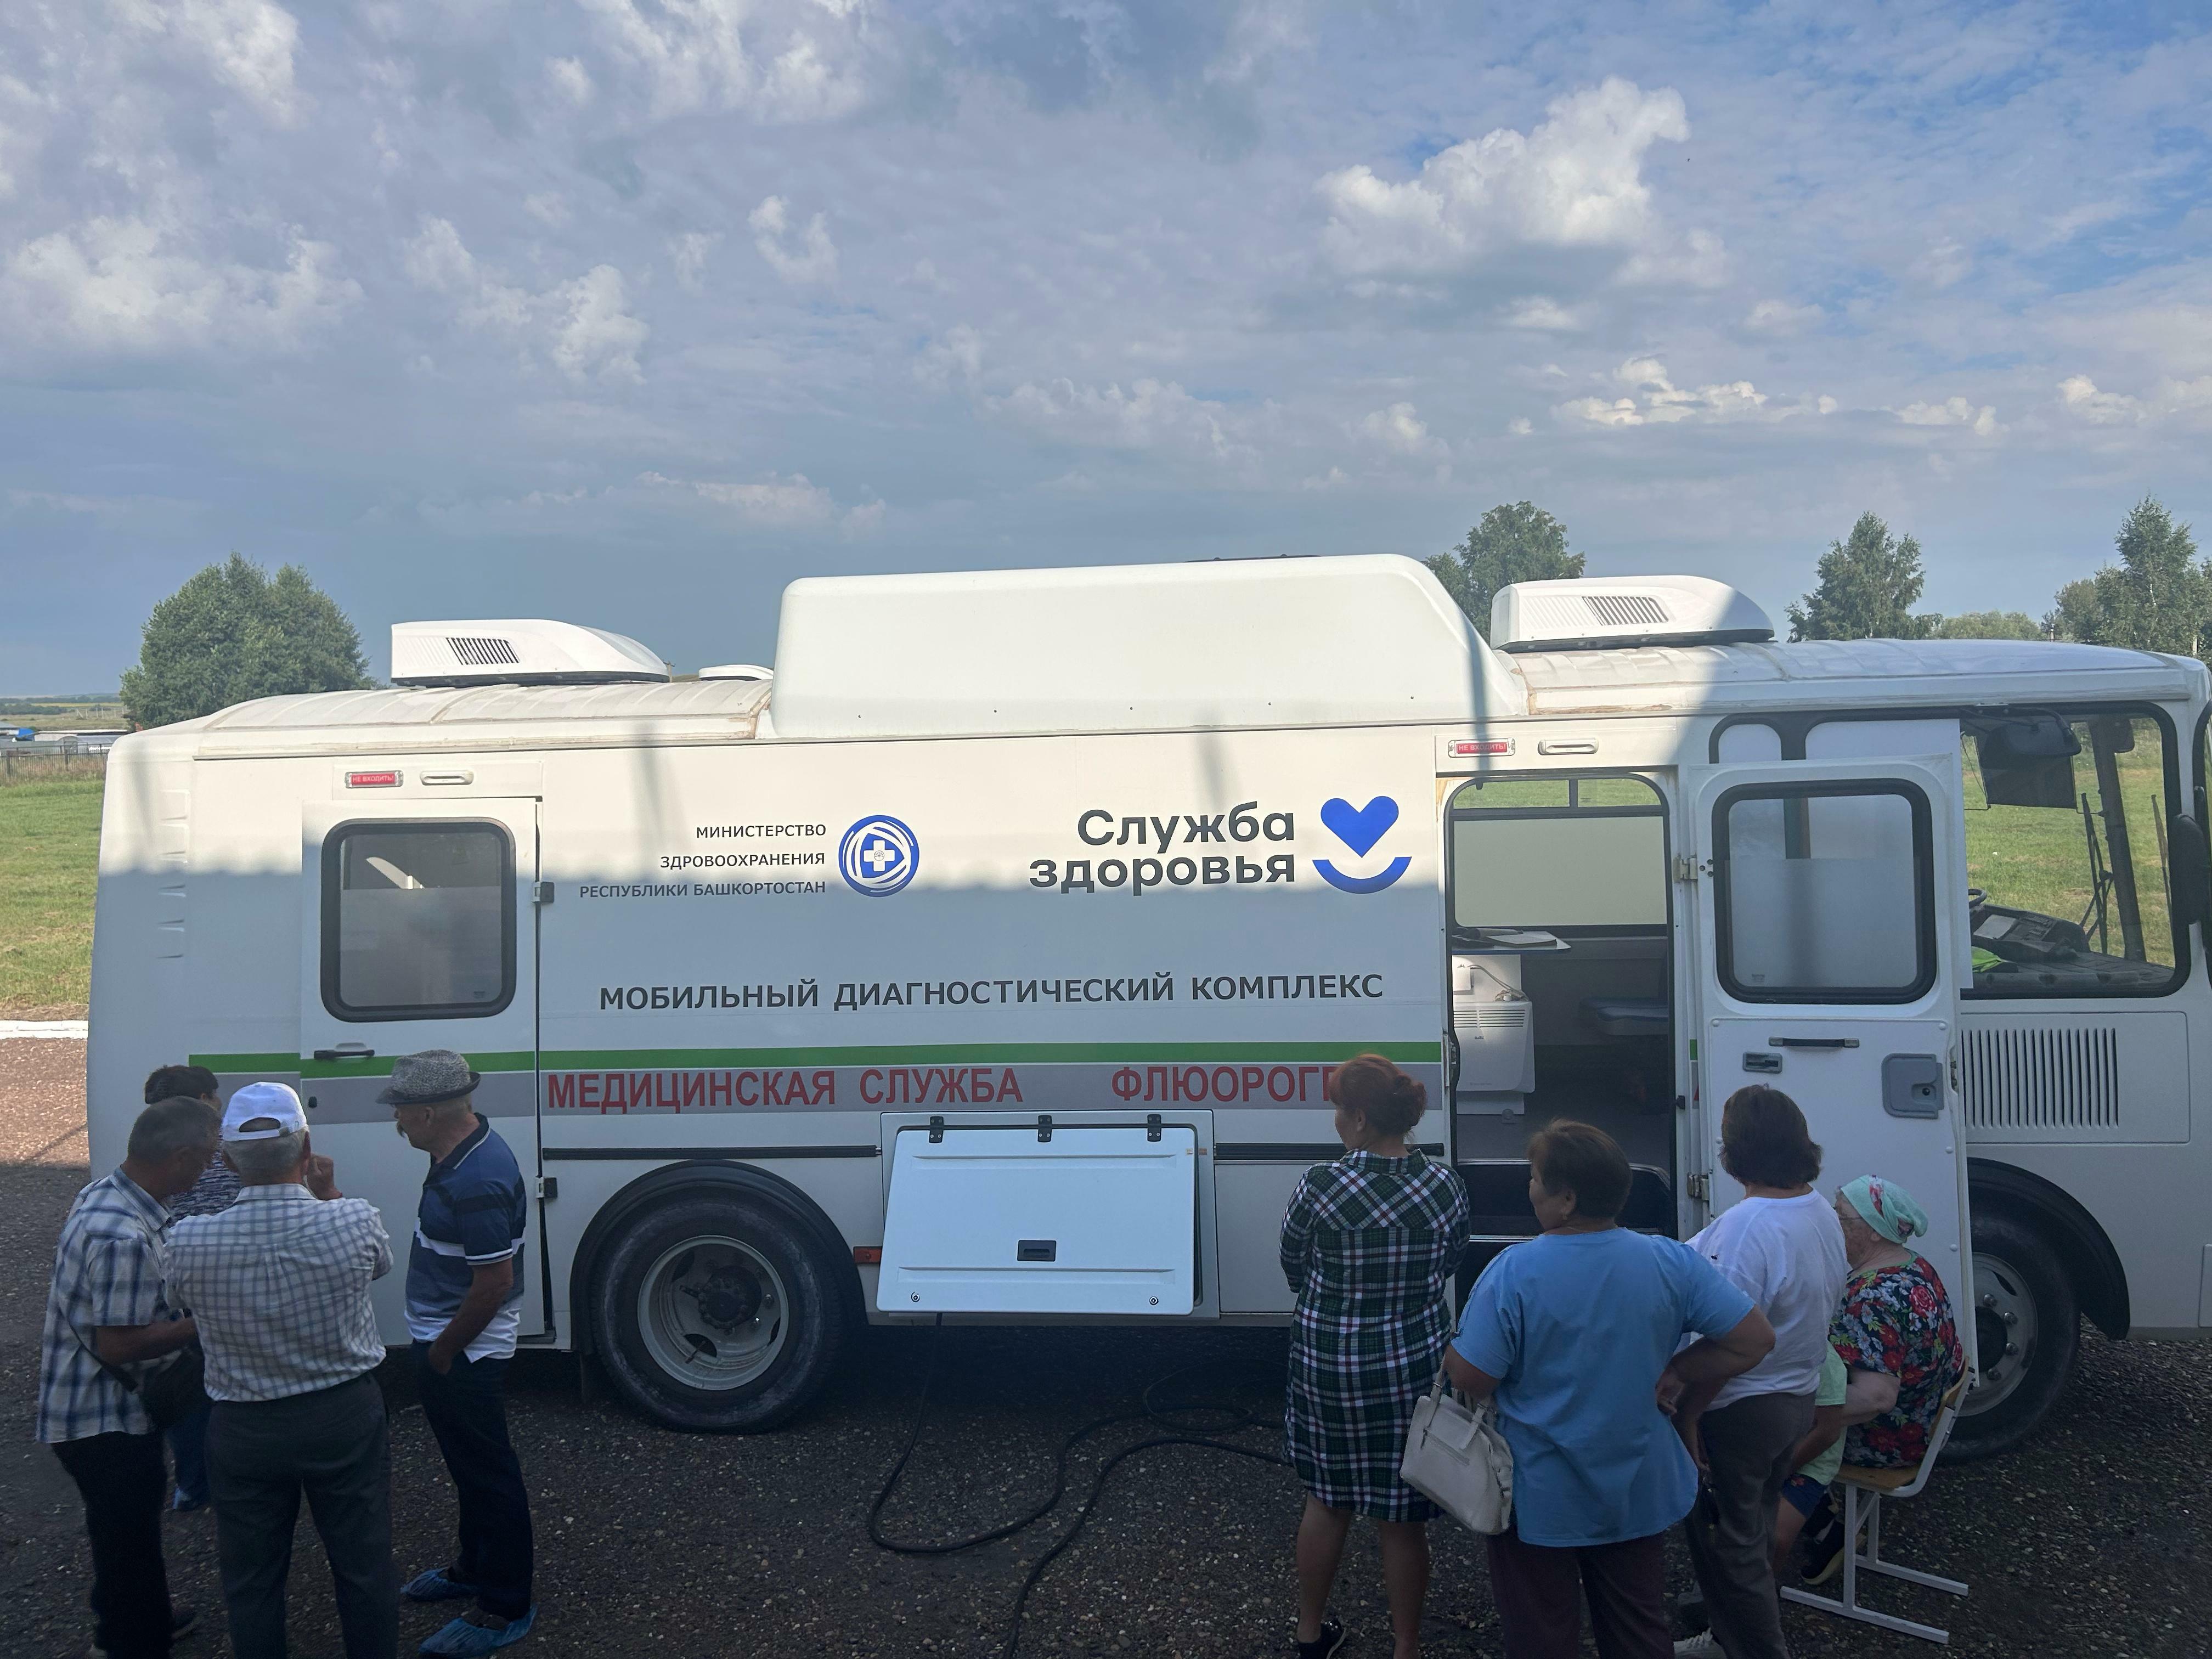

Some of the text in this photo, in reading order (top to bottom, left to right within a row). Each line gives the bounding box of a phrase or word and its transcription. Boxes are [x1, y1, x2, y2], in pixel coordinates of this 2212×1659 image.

[696, 824, 826, 839] МИНИСТЕРСТВО
[1077, 800, 1294, 854] Служба
[660, 853, 825, 871] ЗДРОВООХРАНЕНИЯ
[1029, 854, 1295, 896] здоровья
[579, 881, 826, 898] РЕСПУБЛИКИ БАШКОРТОСТАН
[600, 971, 1383, 1012] МОБИЛЬНЫЙ ДИАГНОСТИЧЕСКИЙ КОМПЛЕКС
[548, 1070, 834, 1114] МЕДИЦИНСКАЯ
[860, 1068, 1023, 1104] СЛУЖБА
